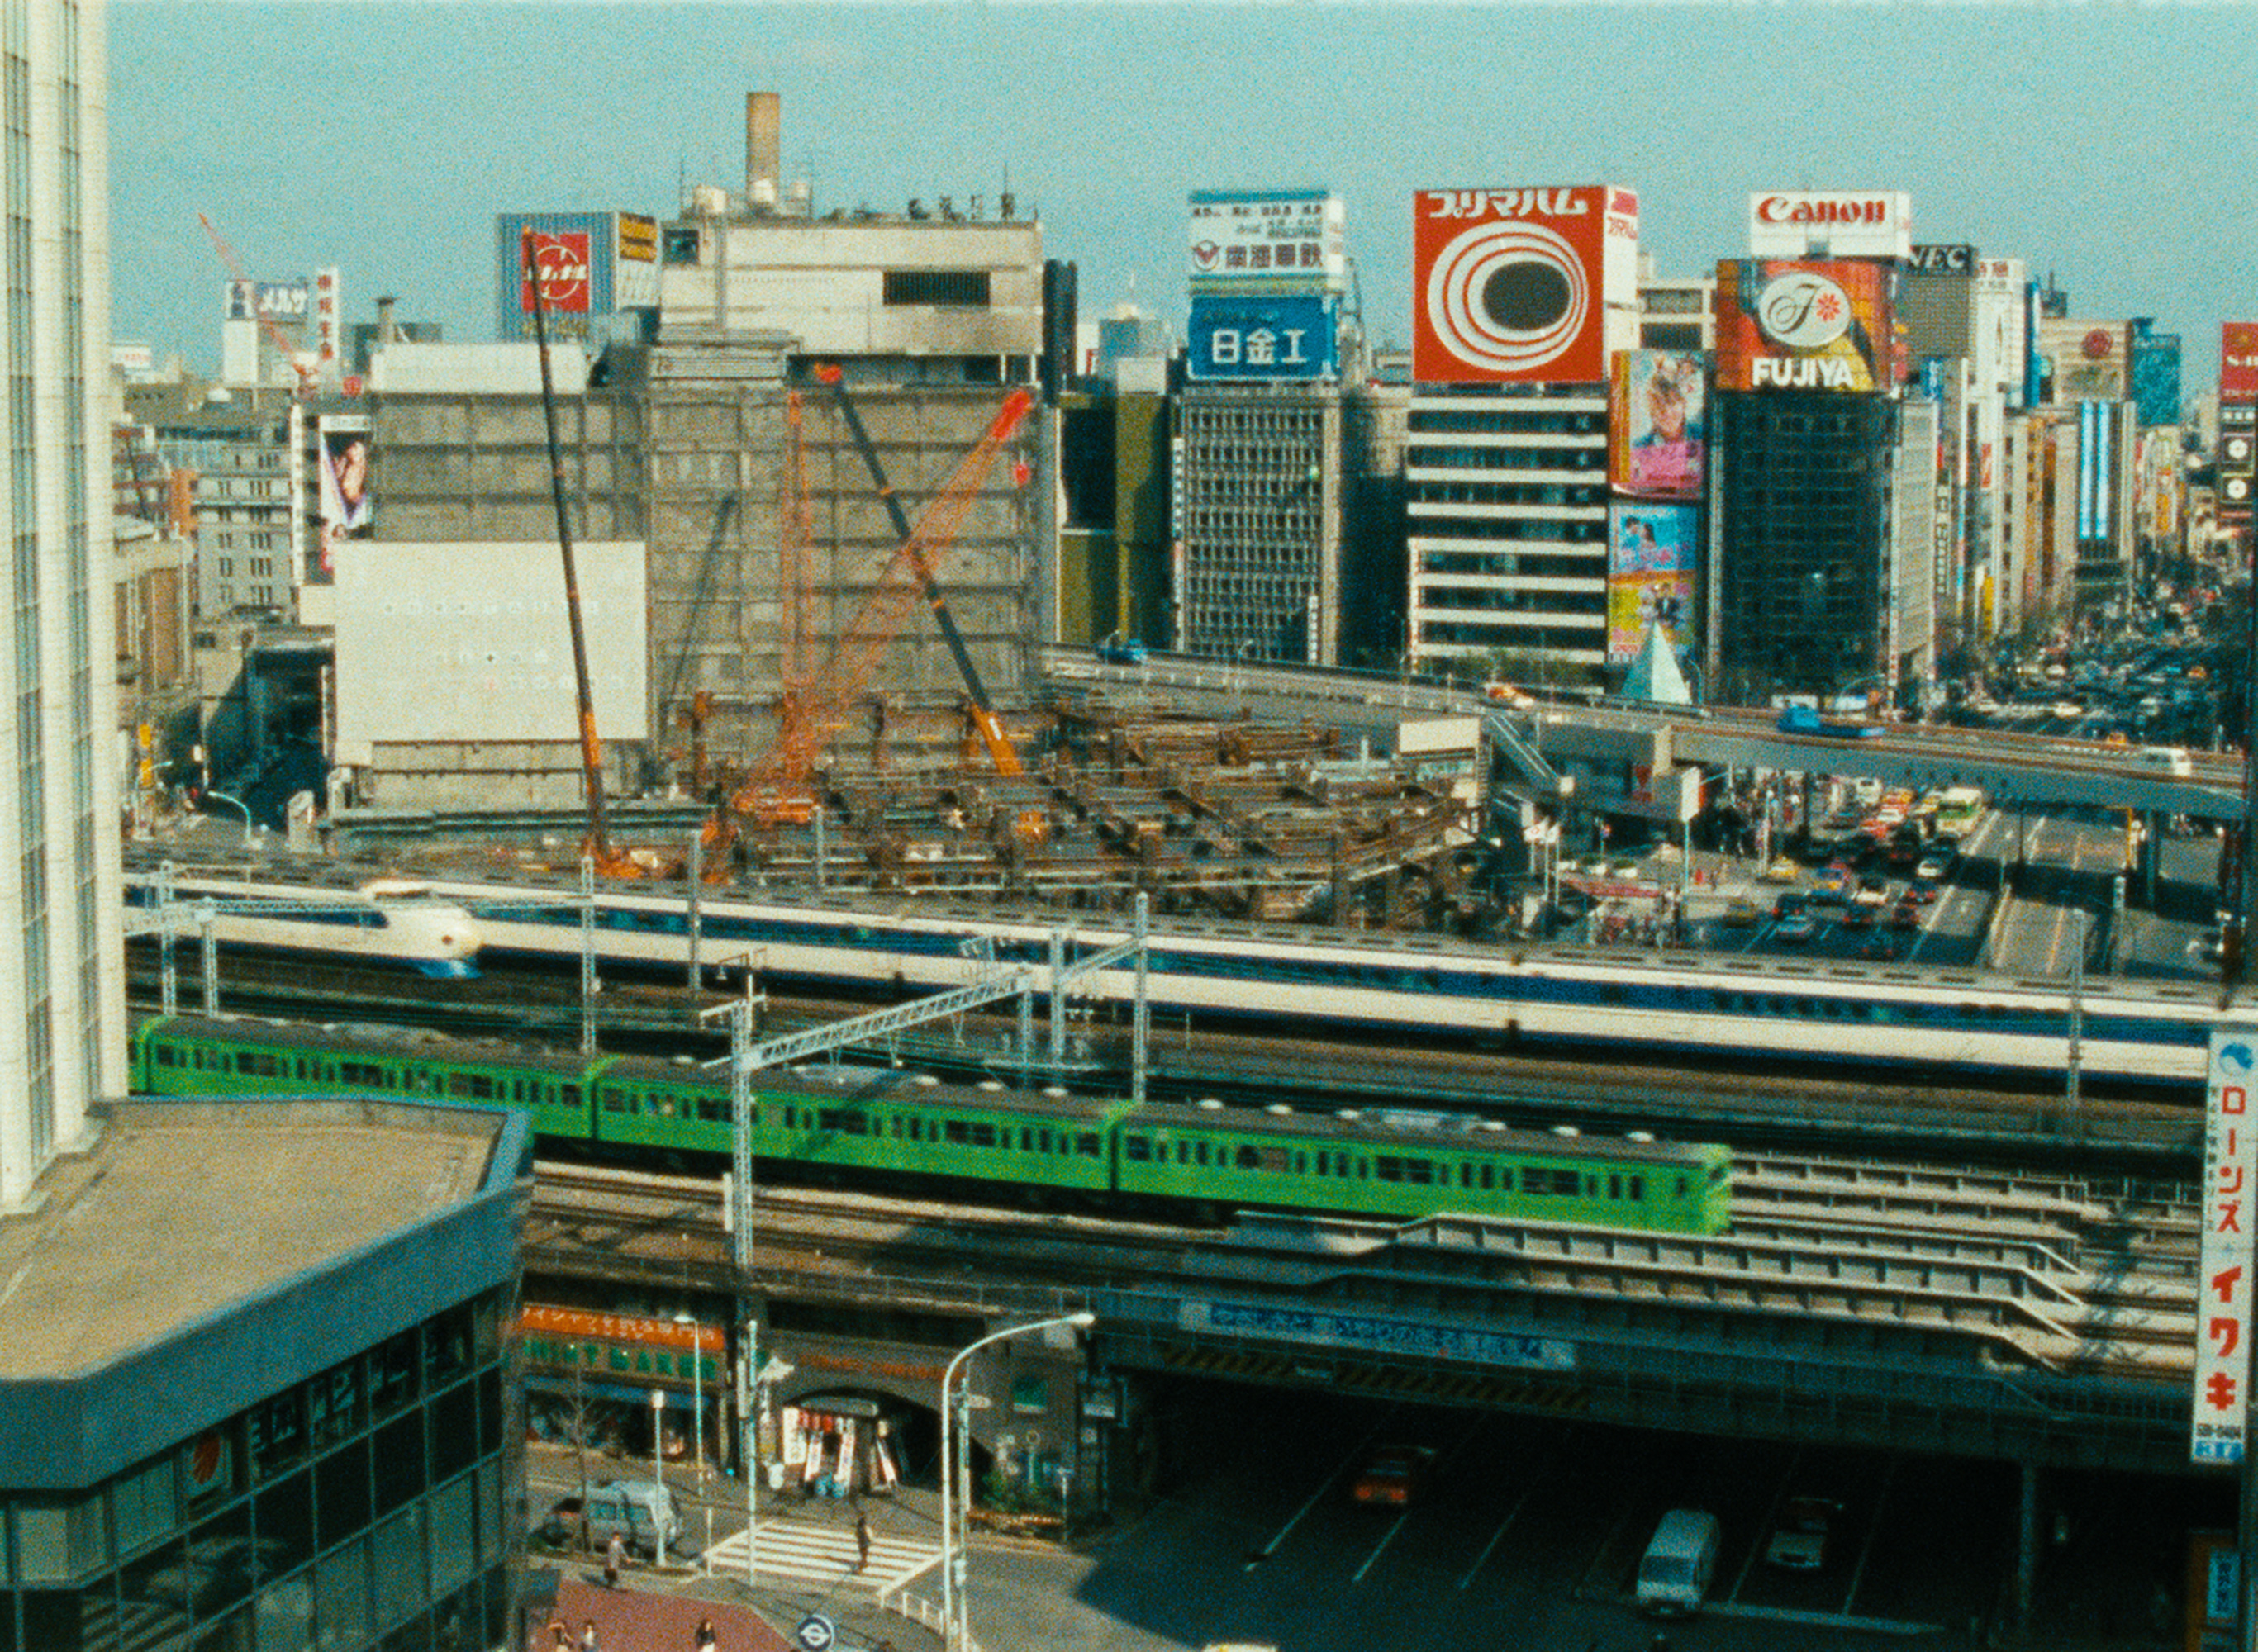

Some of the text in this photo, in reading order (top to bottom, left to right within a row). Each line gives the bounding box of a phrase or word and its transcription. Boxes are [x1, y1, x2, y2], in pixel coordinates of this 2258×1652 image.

[1427, 188, 1588, 218] プリマハム
[1758, 197, 1885, 223] Canon
[1909, 247, 1967, 268] NEC
[1213, 328, 1307, 364] 日金工
[1752, 358, 1855, 387] FUJIYA
[2206, 1265, 2242, 1412] イワキ
